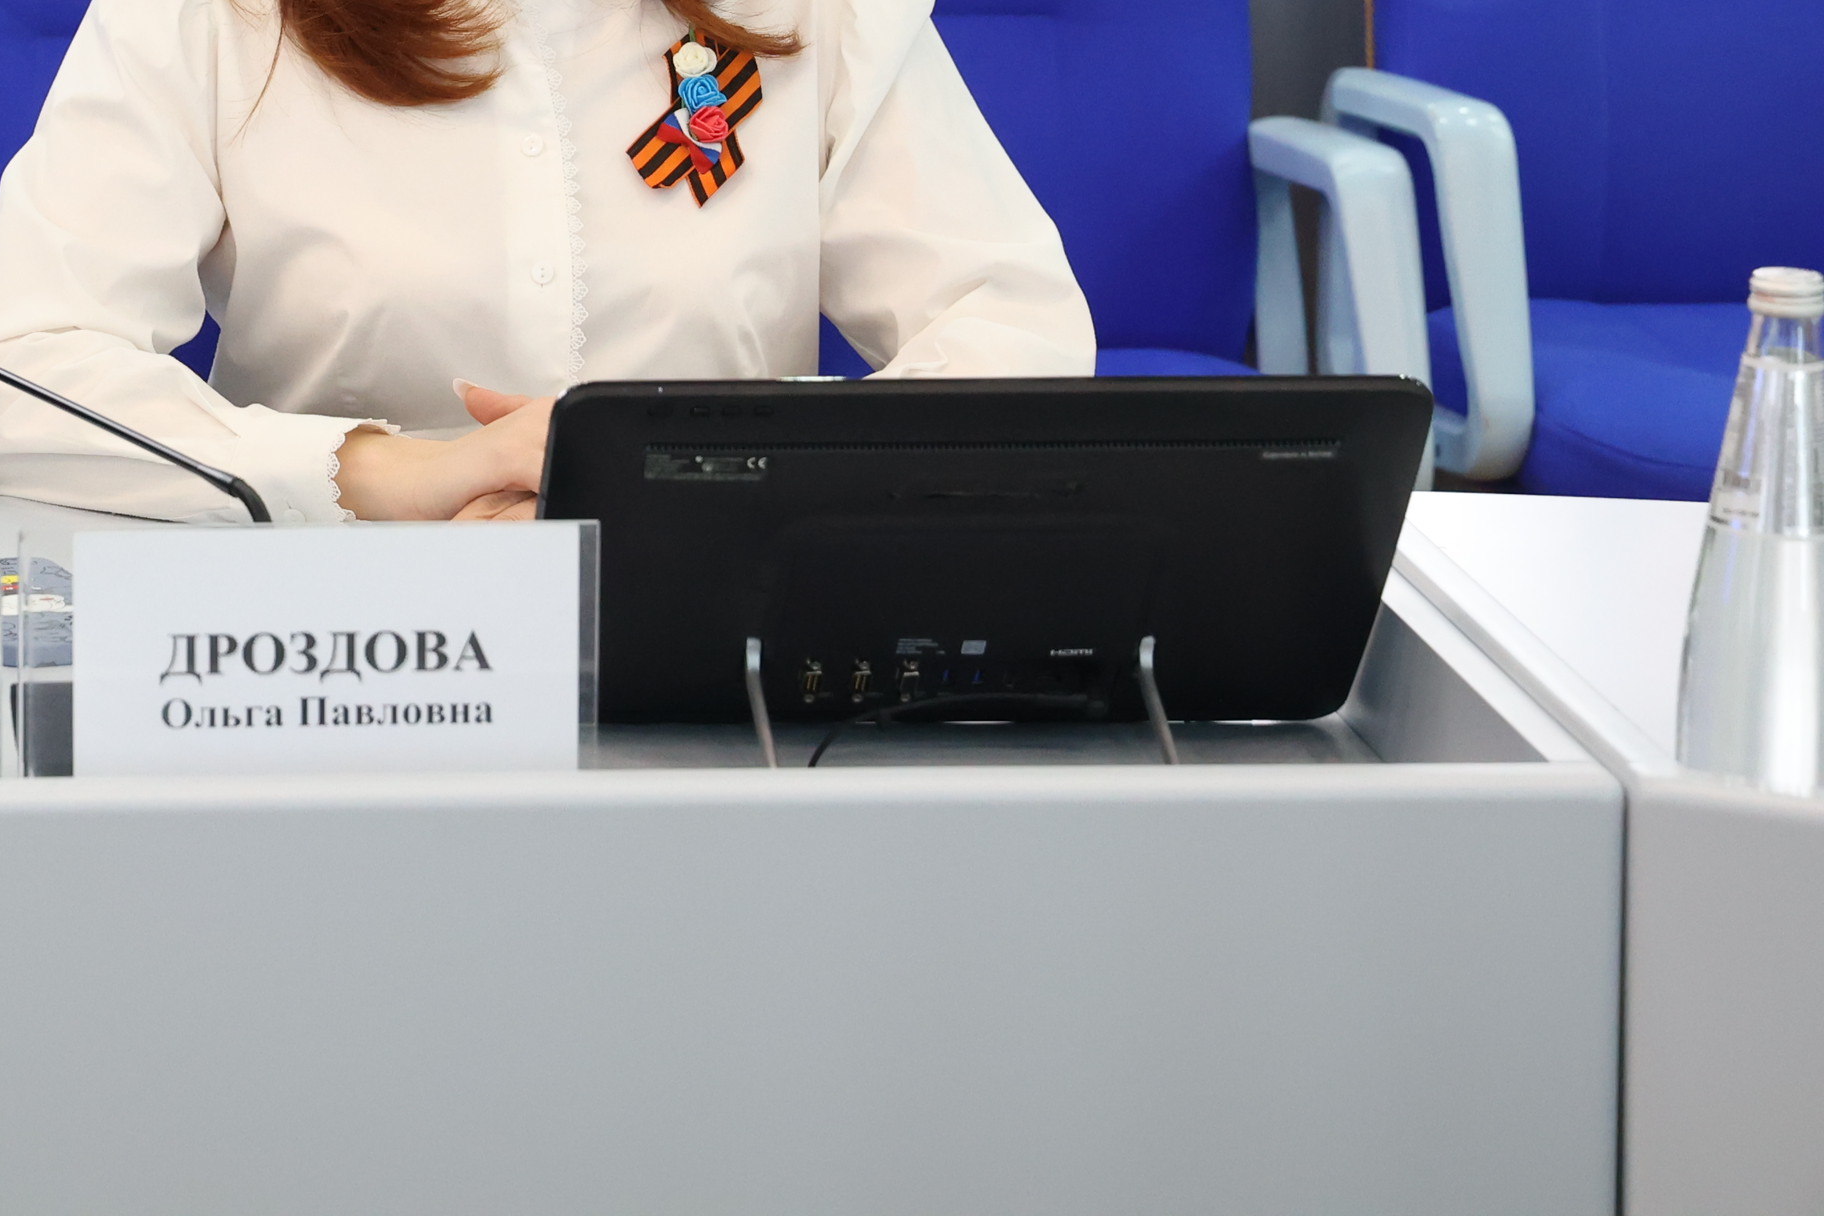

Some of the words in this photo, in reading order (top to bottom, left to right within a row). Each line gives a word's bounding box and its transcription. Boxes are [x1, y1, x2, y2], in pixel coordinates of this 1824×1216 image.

[159, 630, 493, 684] ДРОЗДОВА
[160, 698, 284, 729] Ольга
[299, 696, 493, 727] Павловна
